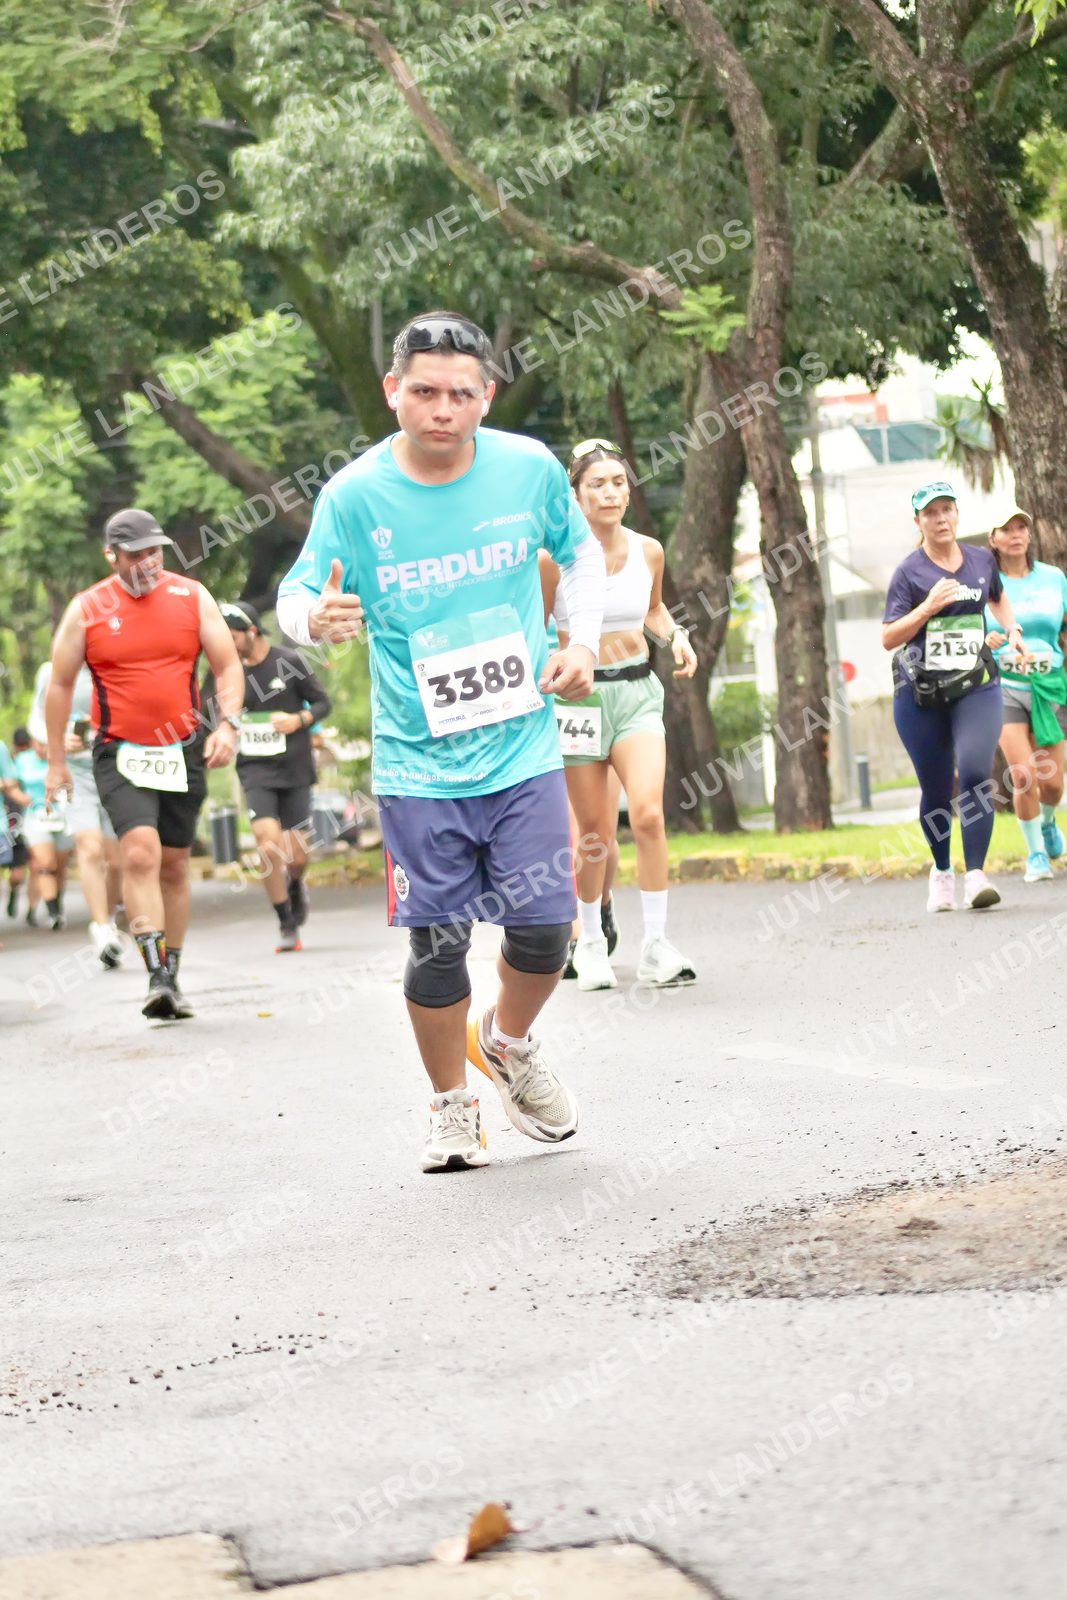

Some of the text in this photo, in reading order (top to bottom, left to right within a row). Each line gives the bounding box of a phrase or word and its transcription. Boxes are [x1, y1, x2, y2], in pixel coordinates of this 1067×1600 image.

[492, 511, 532, 526] BROOKS
[376, 537, 528, 593] PERDURA
[930, 640, 979, 657] 2130
[427, 655, 525, 708] 3389
